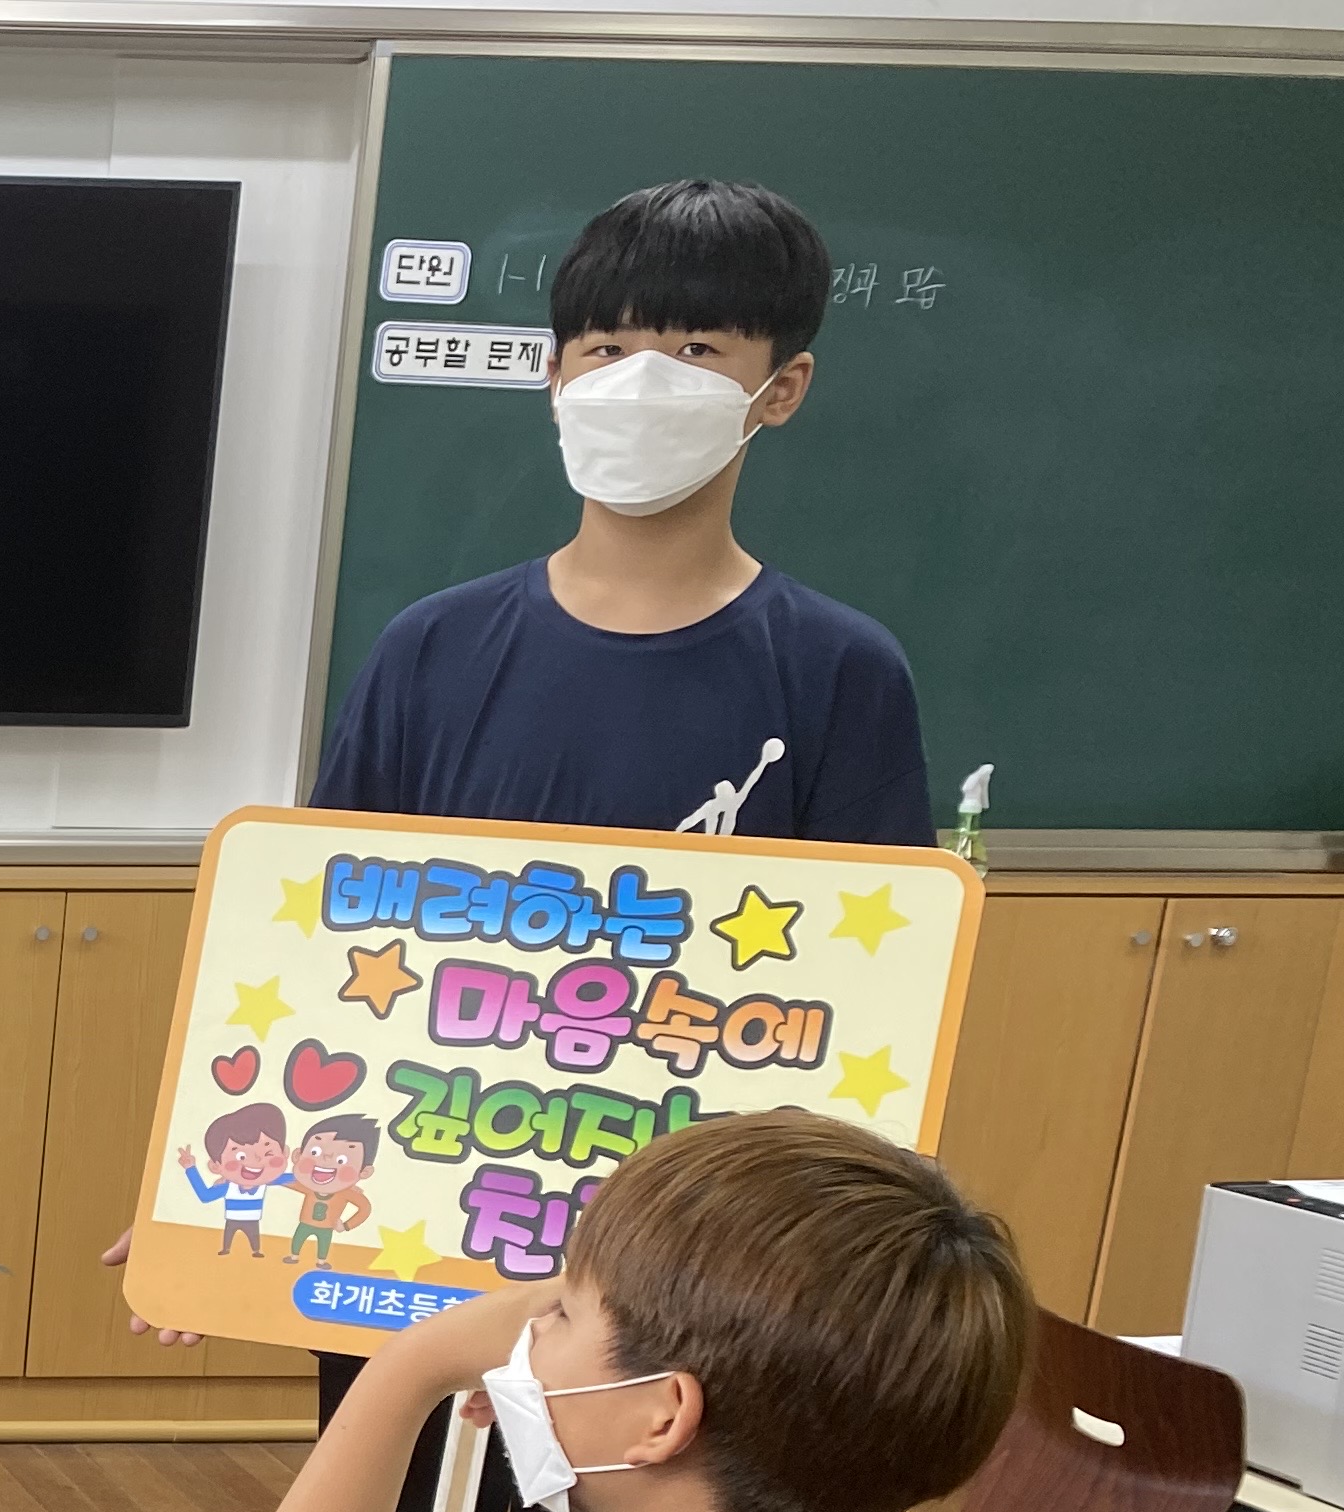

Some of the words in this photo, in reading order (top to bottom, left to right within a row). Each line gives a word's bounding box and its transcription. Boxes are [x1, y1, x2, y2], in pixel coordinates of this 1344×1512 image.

[396, 253, 455, 287] 단원
[895, 266, 947, 310] 모습
[385, 337, 471, 367] 공부할
[487, 341, 544, 372] 문제
[327, 855, 689, 963] 배려하는
[468, 1170, 600, 1274] 친
